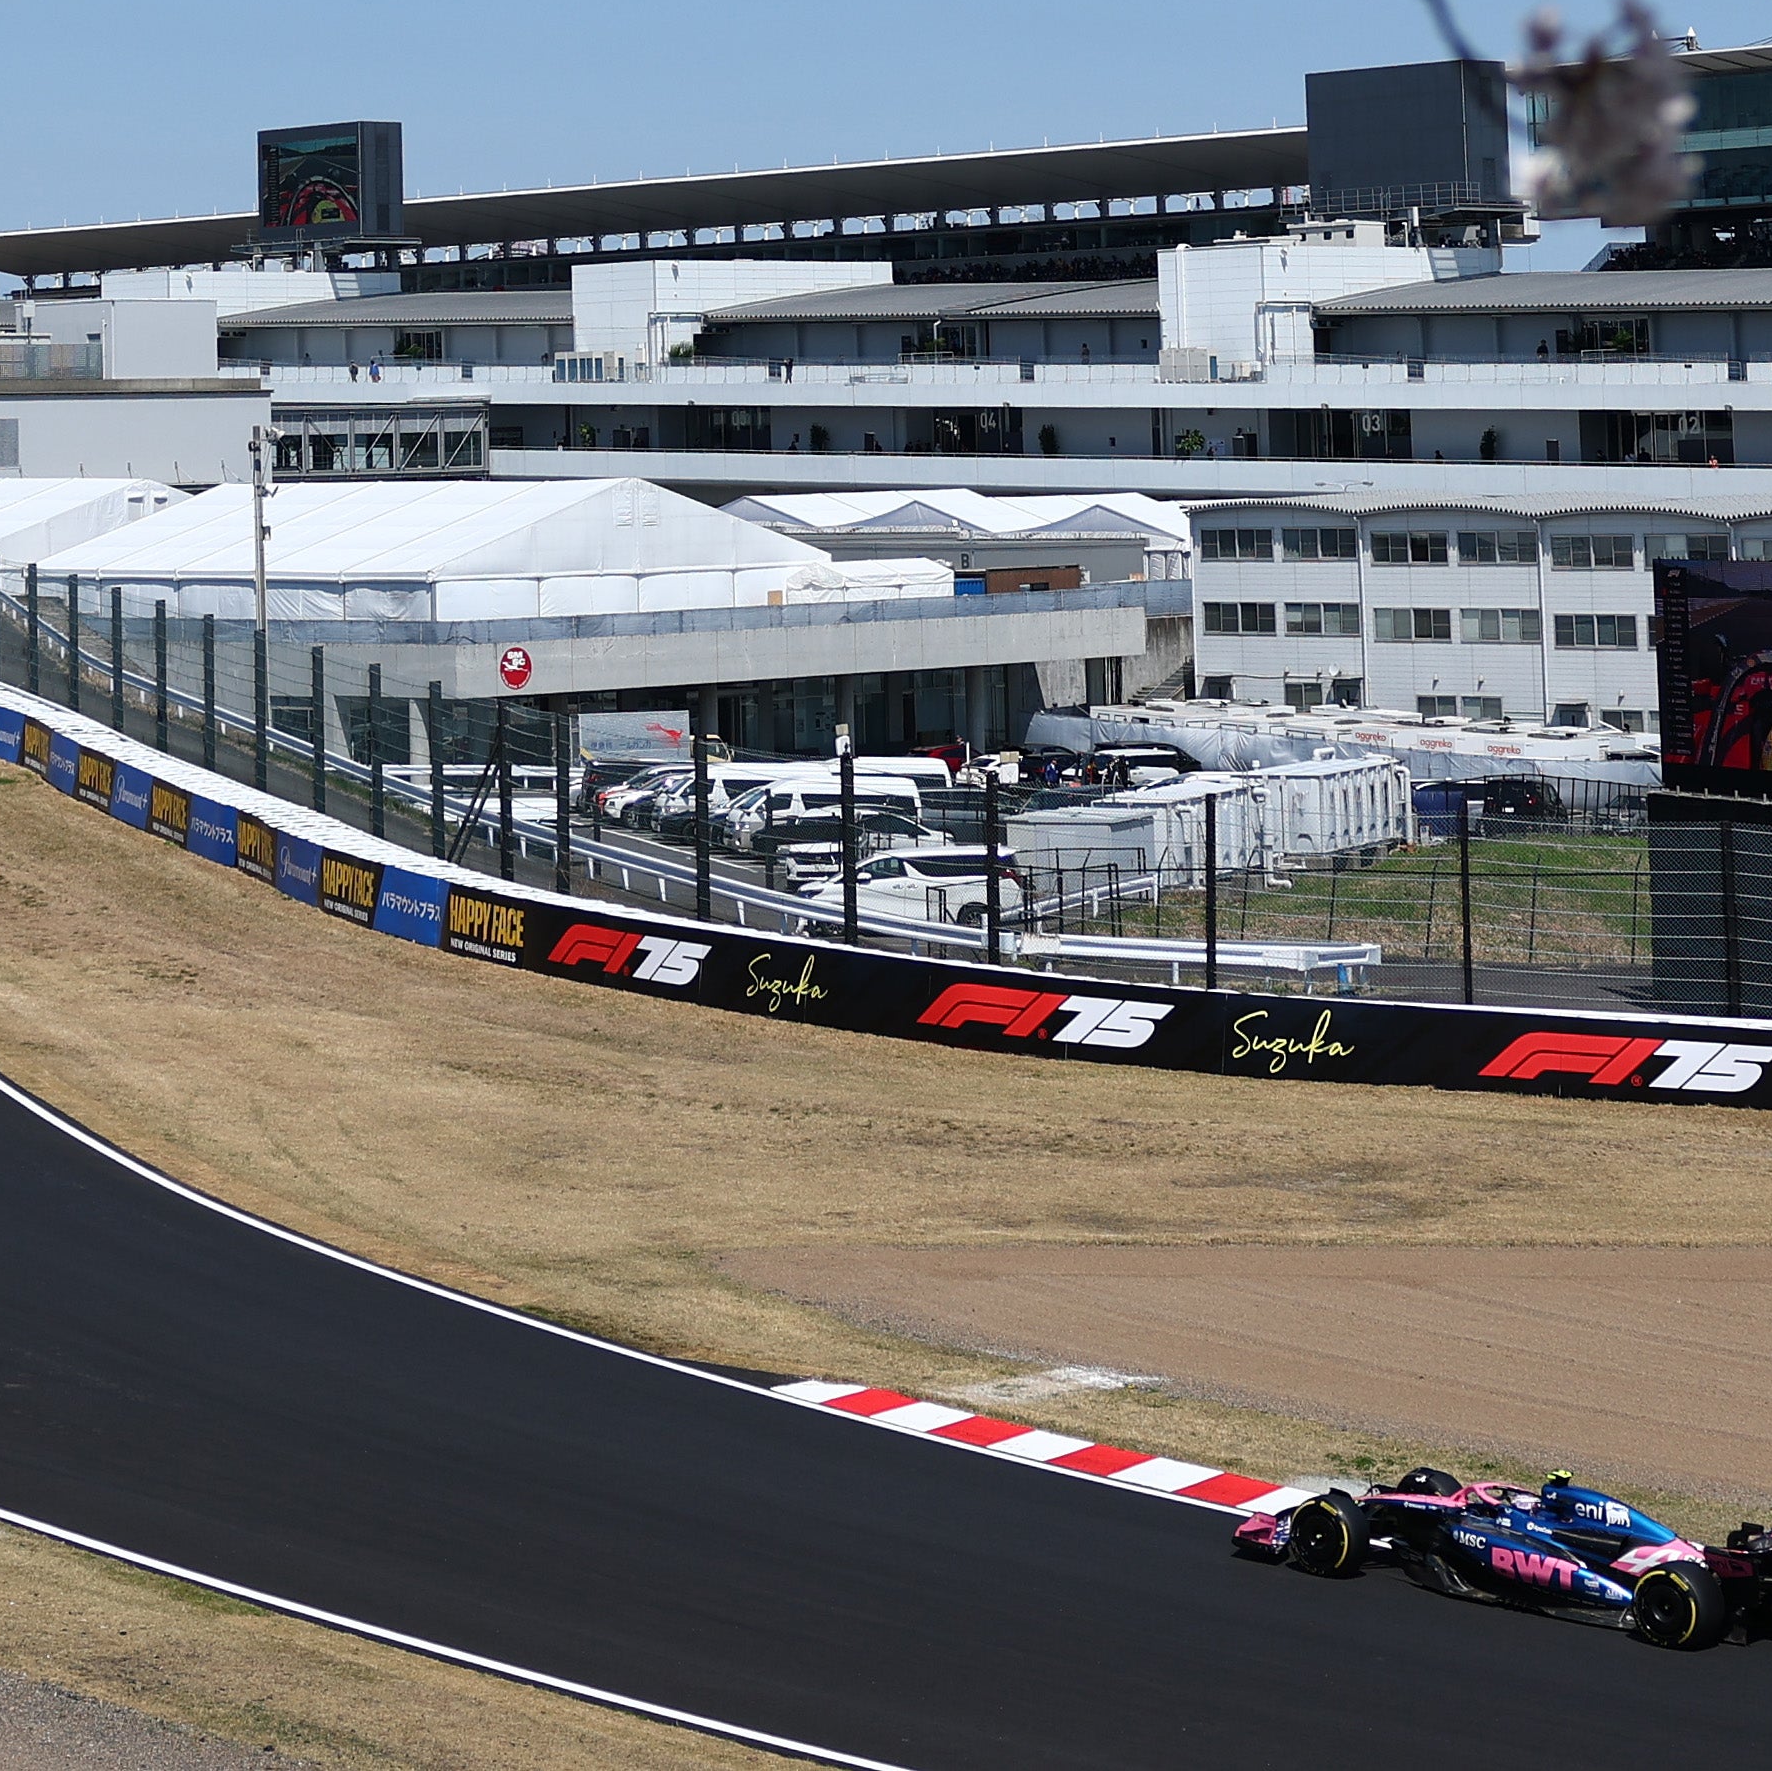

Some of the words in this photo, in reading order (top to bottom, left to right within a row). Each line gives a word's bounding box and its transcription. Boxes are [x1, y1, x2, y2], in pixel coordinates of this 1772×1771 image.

[980, 412, 997, 428] 04
[1362, 415, 1380, 432] 03
[1679, 416, 1700, 434] 02
[961, 553, 969, 569] B
[1355, 731, 1386, 742] aggreko
[1420, 737, 1453, 749] aggreko
[1487, 744, 1521, 756] aggreko
[323, 859, 353, 903] HAPPY
[353, 867, 375, 908] FACE
[382, 891, 441, 923] パラマウントプラス
[449, 894, 490, 942] HAPPY
[491, 905, 525, 947] FACE
[450, 937, 463, 949] NEW
[465, 940, 491, 958] ORIGINAL
[493, 947, 516, 962] SERIES
[746, 954, 828, 1012] Suzuka
[1233, 1009, 1355, 1073] Suzuka
[1575, 1502, 1604, 1520] eni
[1459, 1531, 1486, 1549] MSC
[1491, 1547, 1579, 1591] BWT
